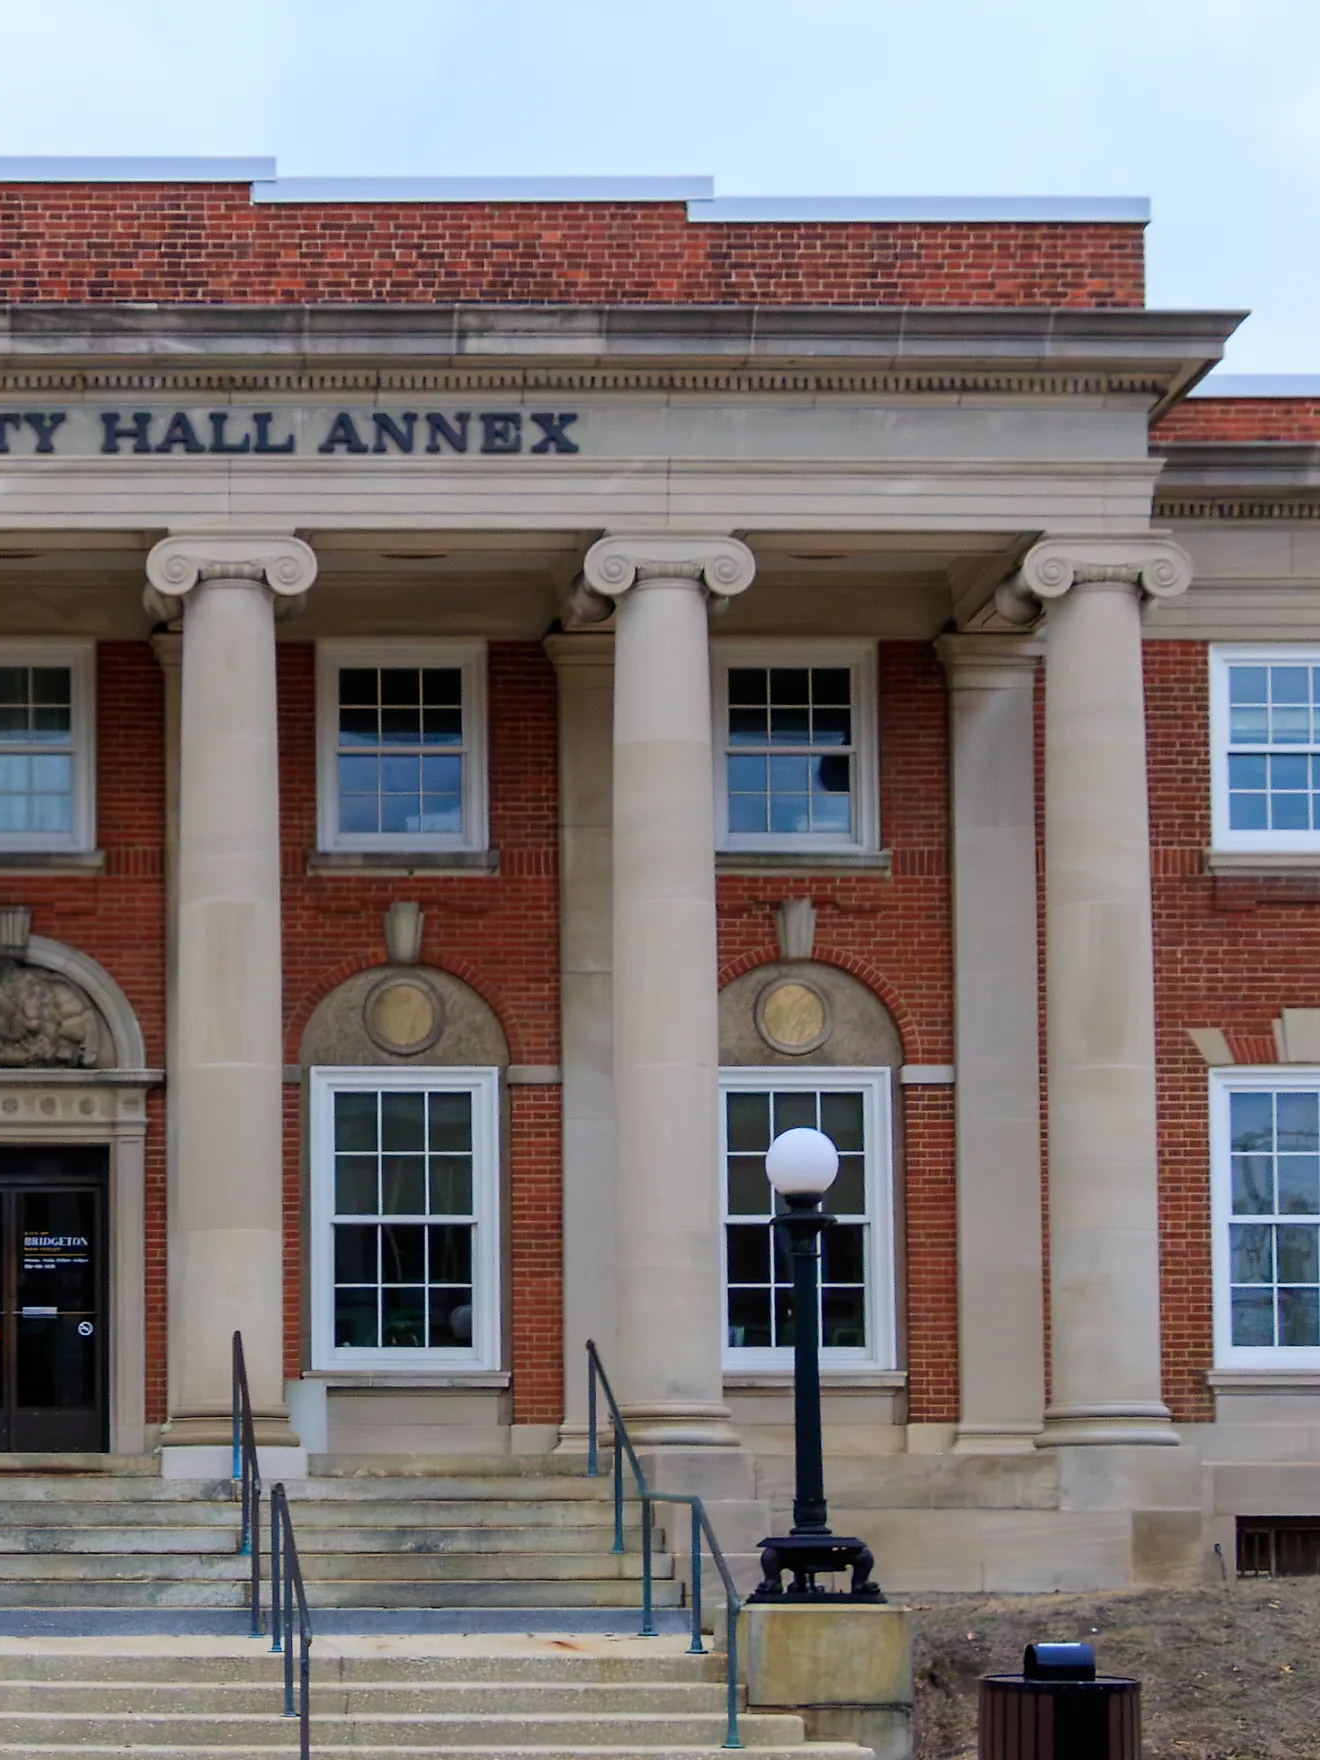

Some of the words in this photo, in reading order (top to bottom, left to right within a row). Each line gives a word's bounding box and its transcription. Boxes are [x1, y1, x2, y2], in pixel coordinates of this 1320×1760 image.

[100, 412, 295, 453] HALL
[318, 412, 578, 453] ANNEX
[24, 1236, 89, 1246] BRIDGETON
